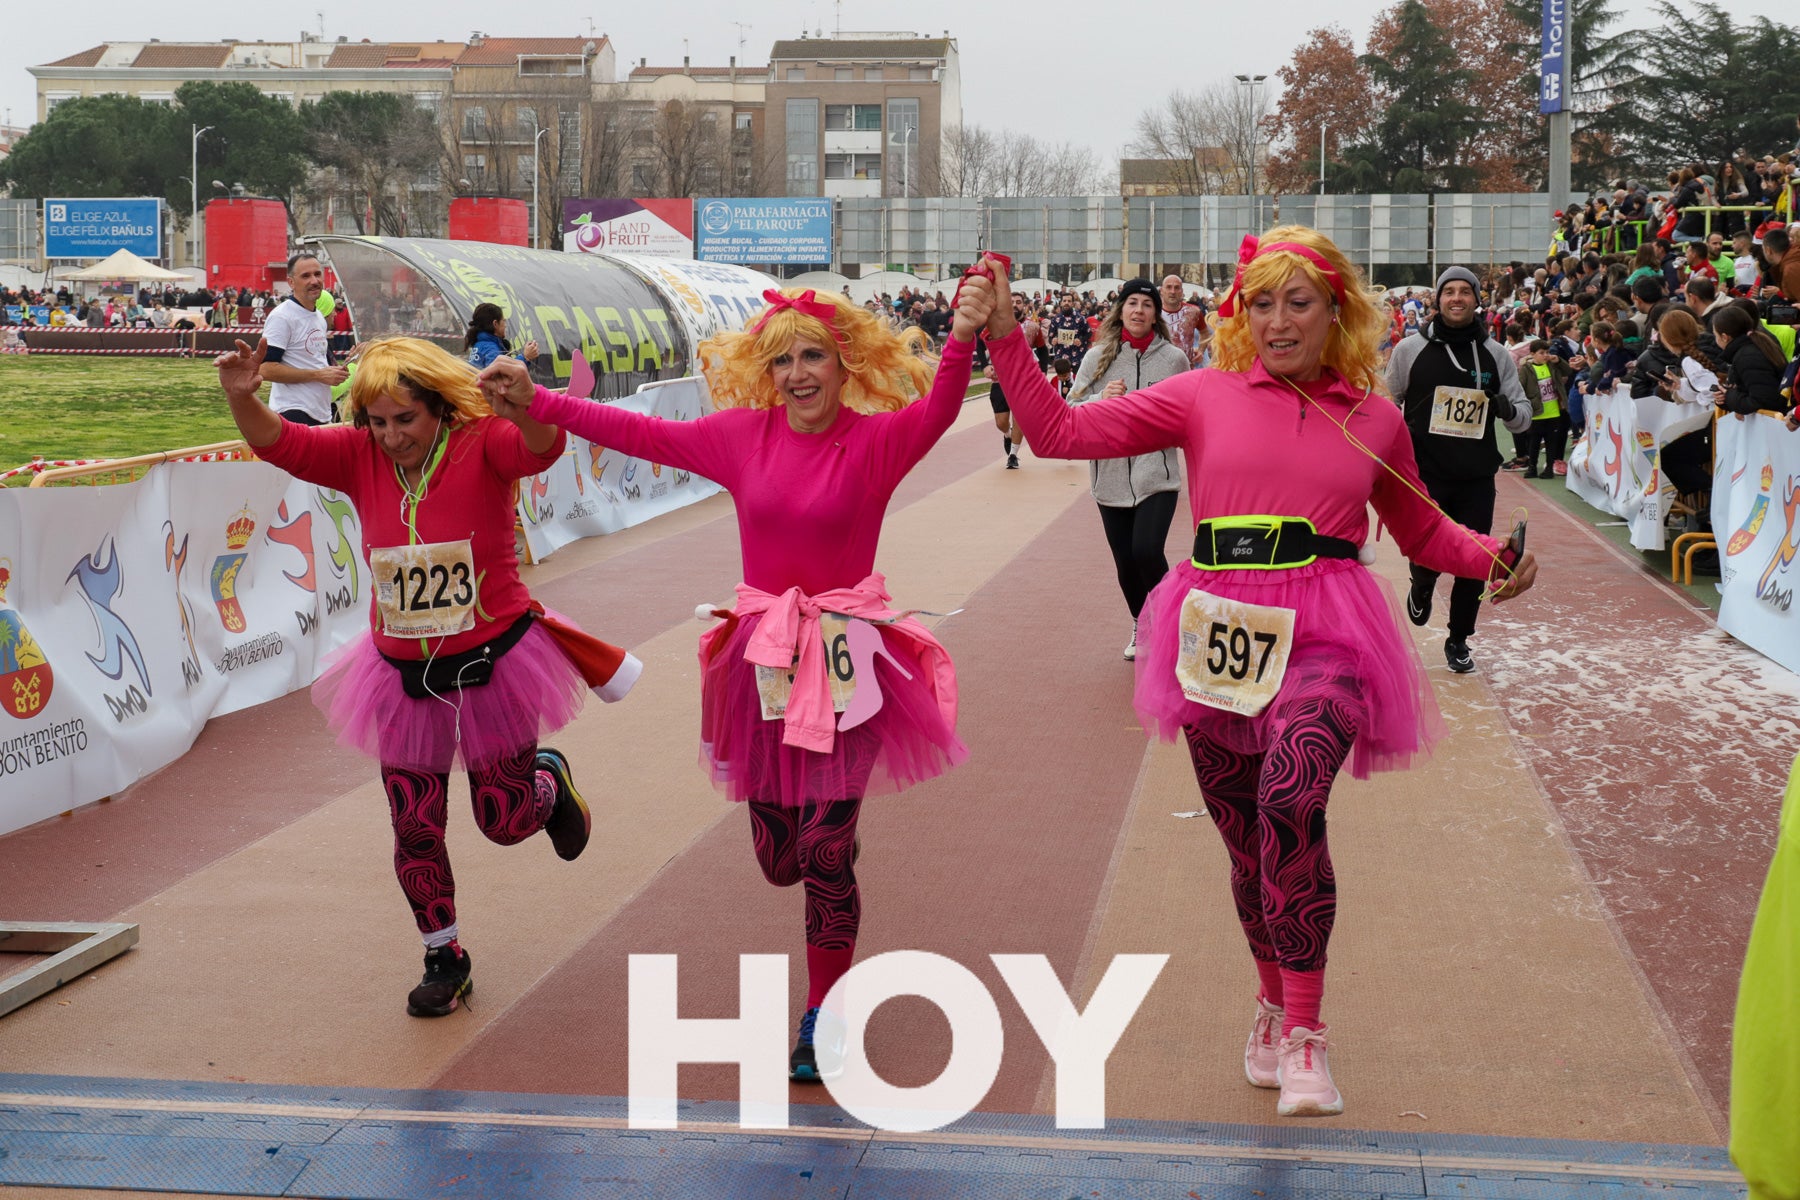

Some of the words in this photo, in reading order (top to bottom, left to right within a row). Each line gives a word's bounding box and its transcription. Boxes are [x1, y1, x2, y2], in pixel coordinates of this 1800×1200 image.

[71, 211, 102, 222] ELIGE
[103, 211, 131, 222] AZUL
[734, 206, 828, 218] PARAFARMACIA
[50, 225, 80, 236] ELIGE
[81, 224, 111, 236] FÉLIX
[111, 223, 154, 236] BAÑULS
[608, 221, 650, 234] LAND
[608, 232, 650, 246] FRUIT
[704, 237, 730, 245] HIGIENE
[732, 237, 753, 245] BUCAL
[758, 237, 788, 245] CUIDADO
[789, 237, 825, 245] CORPORAL
[704, 253, 738, 261] DIETÉTICA
[746, 253, 783, 261] NUTRICIÓN
[748, 245, 797, 253] ALIMENTACIÓN
[535, 305, 674, 378] CASAT
[1444, 397, 1485, 425] 1821
[393, 561, 473, 612] 1223
[1762, 579, 1792, 611] DMD
[247, 640, 284, 665] BENITO
[1206, 621, 1278, 684] 597
[103, 684, 148, 723] DMD
[36, 730, 88, 766] BENITO
